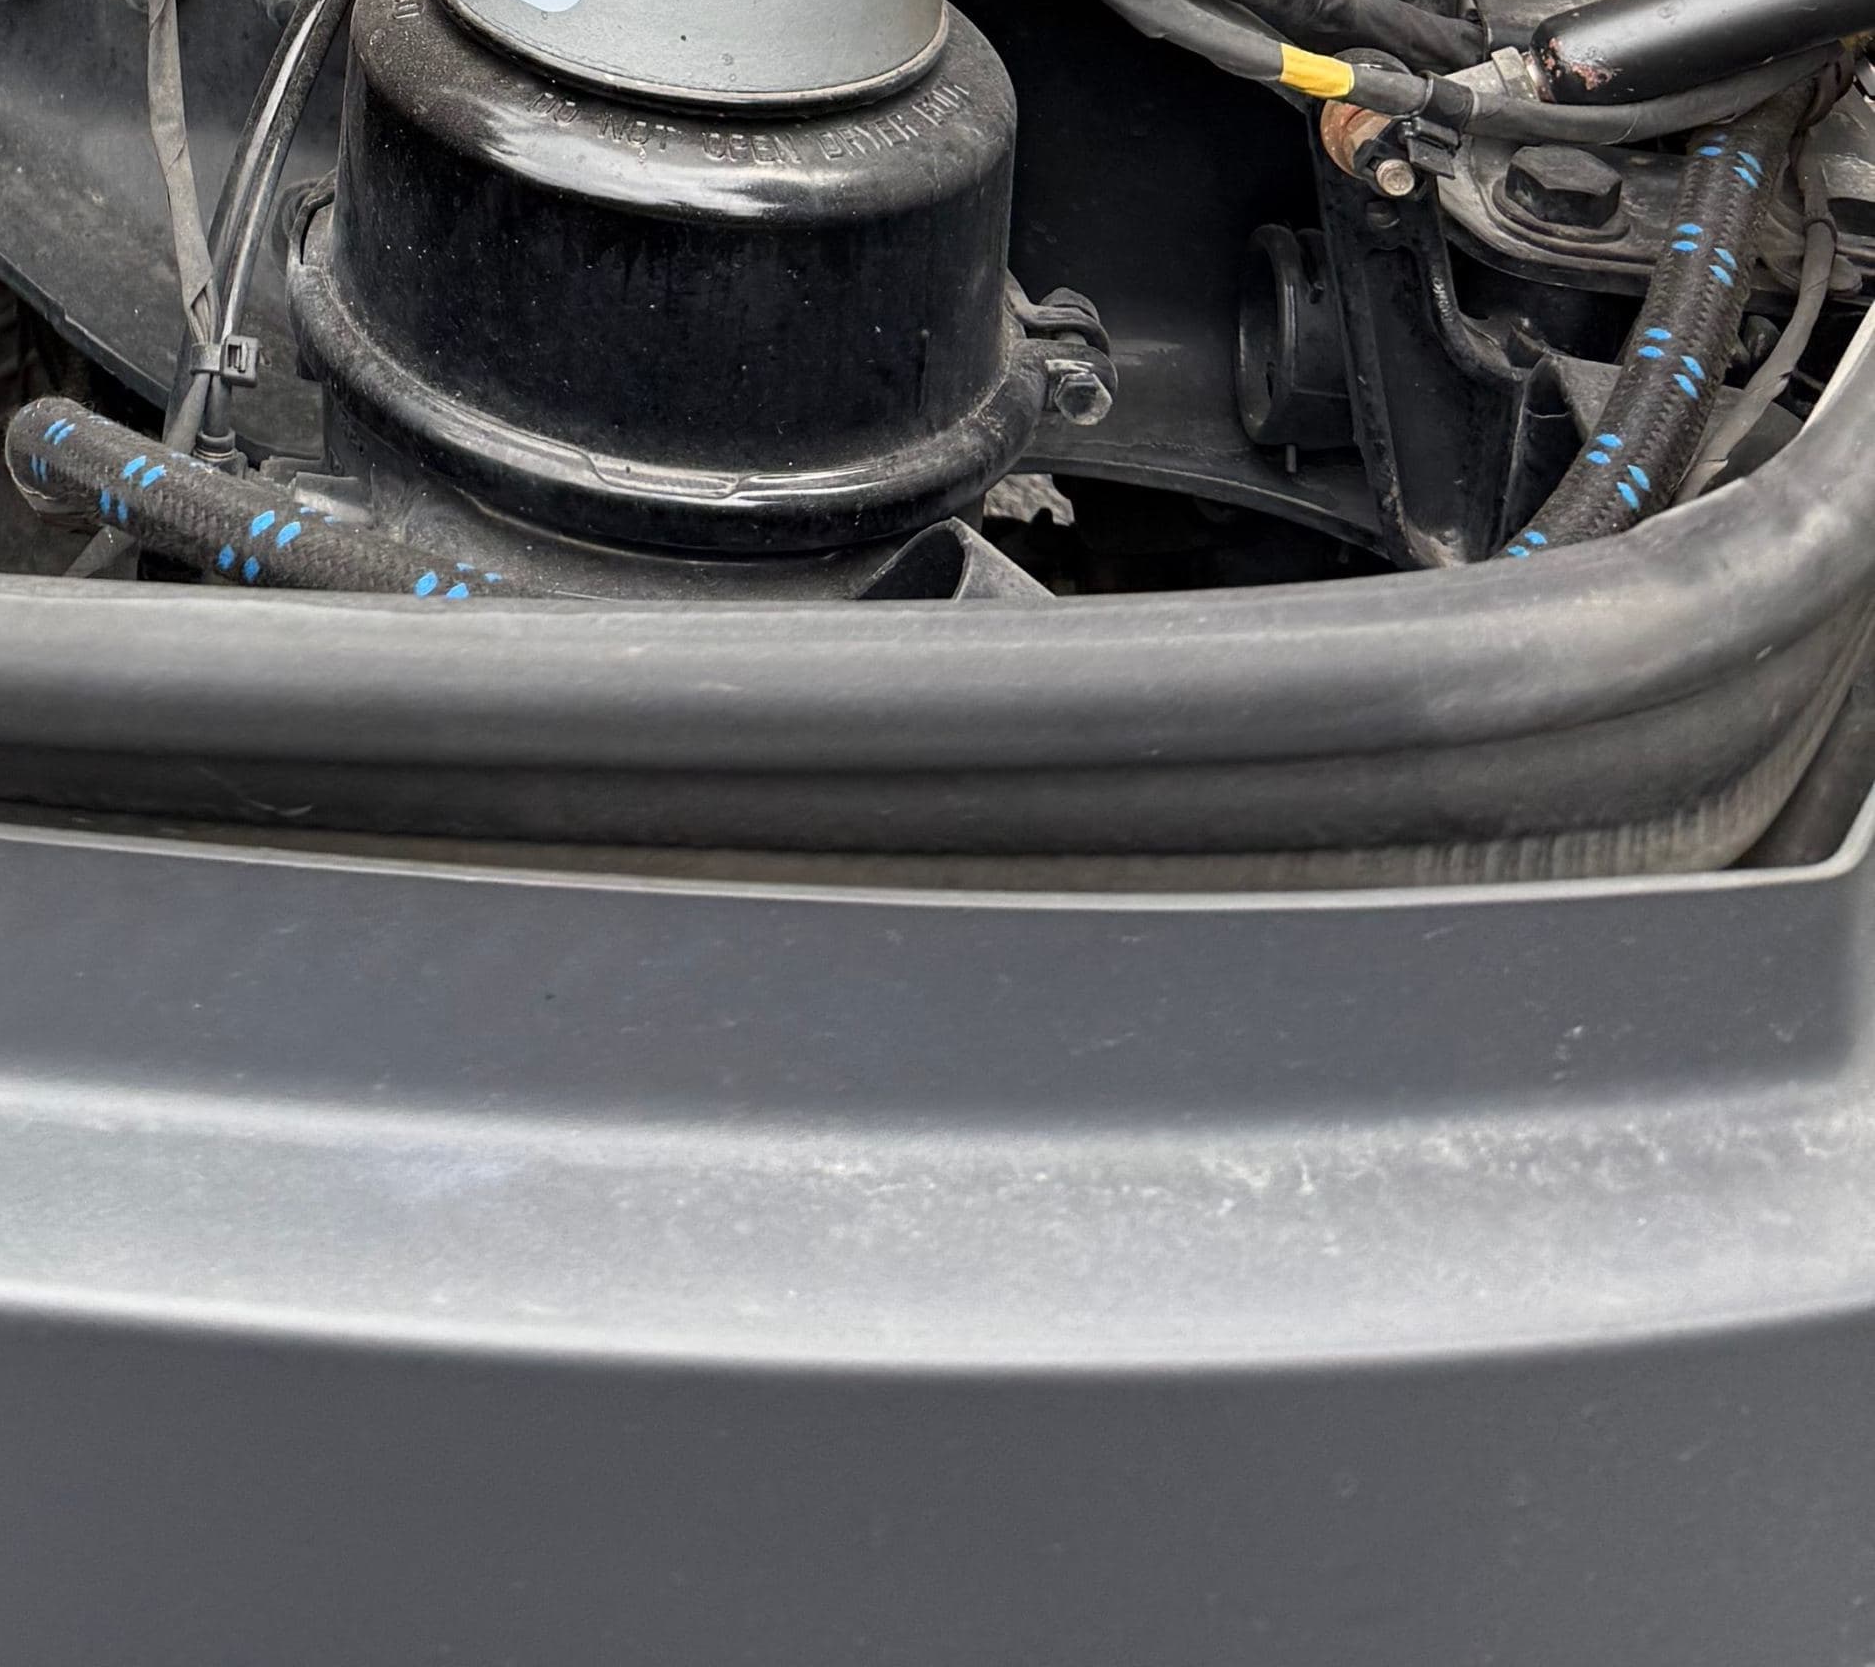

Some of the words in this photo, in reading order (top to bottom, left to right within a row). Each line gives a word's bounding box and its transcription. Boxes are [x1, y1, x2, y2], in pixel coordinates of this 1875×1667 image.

[528, 92, 580, 125] DO
[597, 112, 680, 152] NOT
[702, 131, 802, 165] OPEN
[820, 114, 919, 161] DRYER
